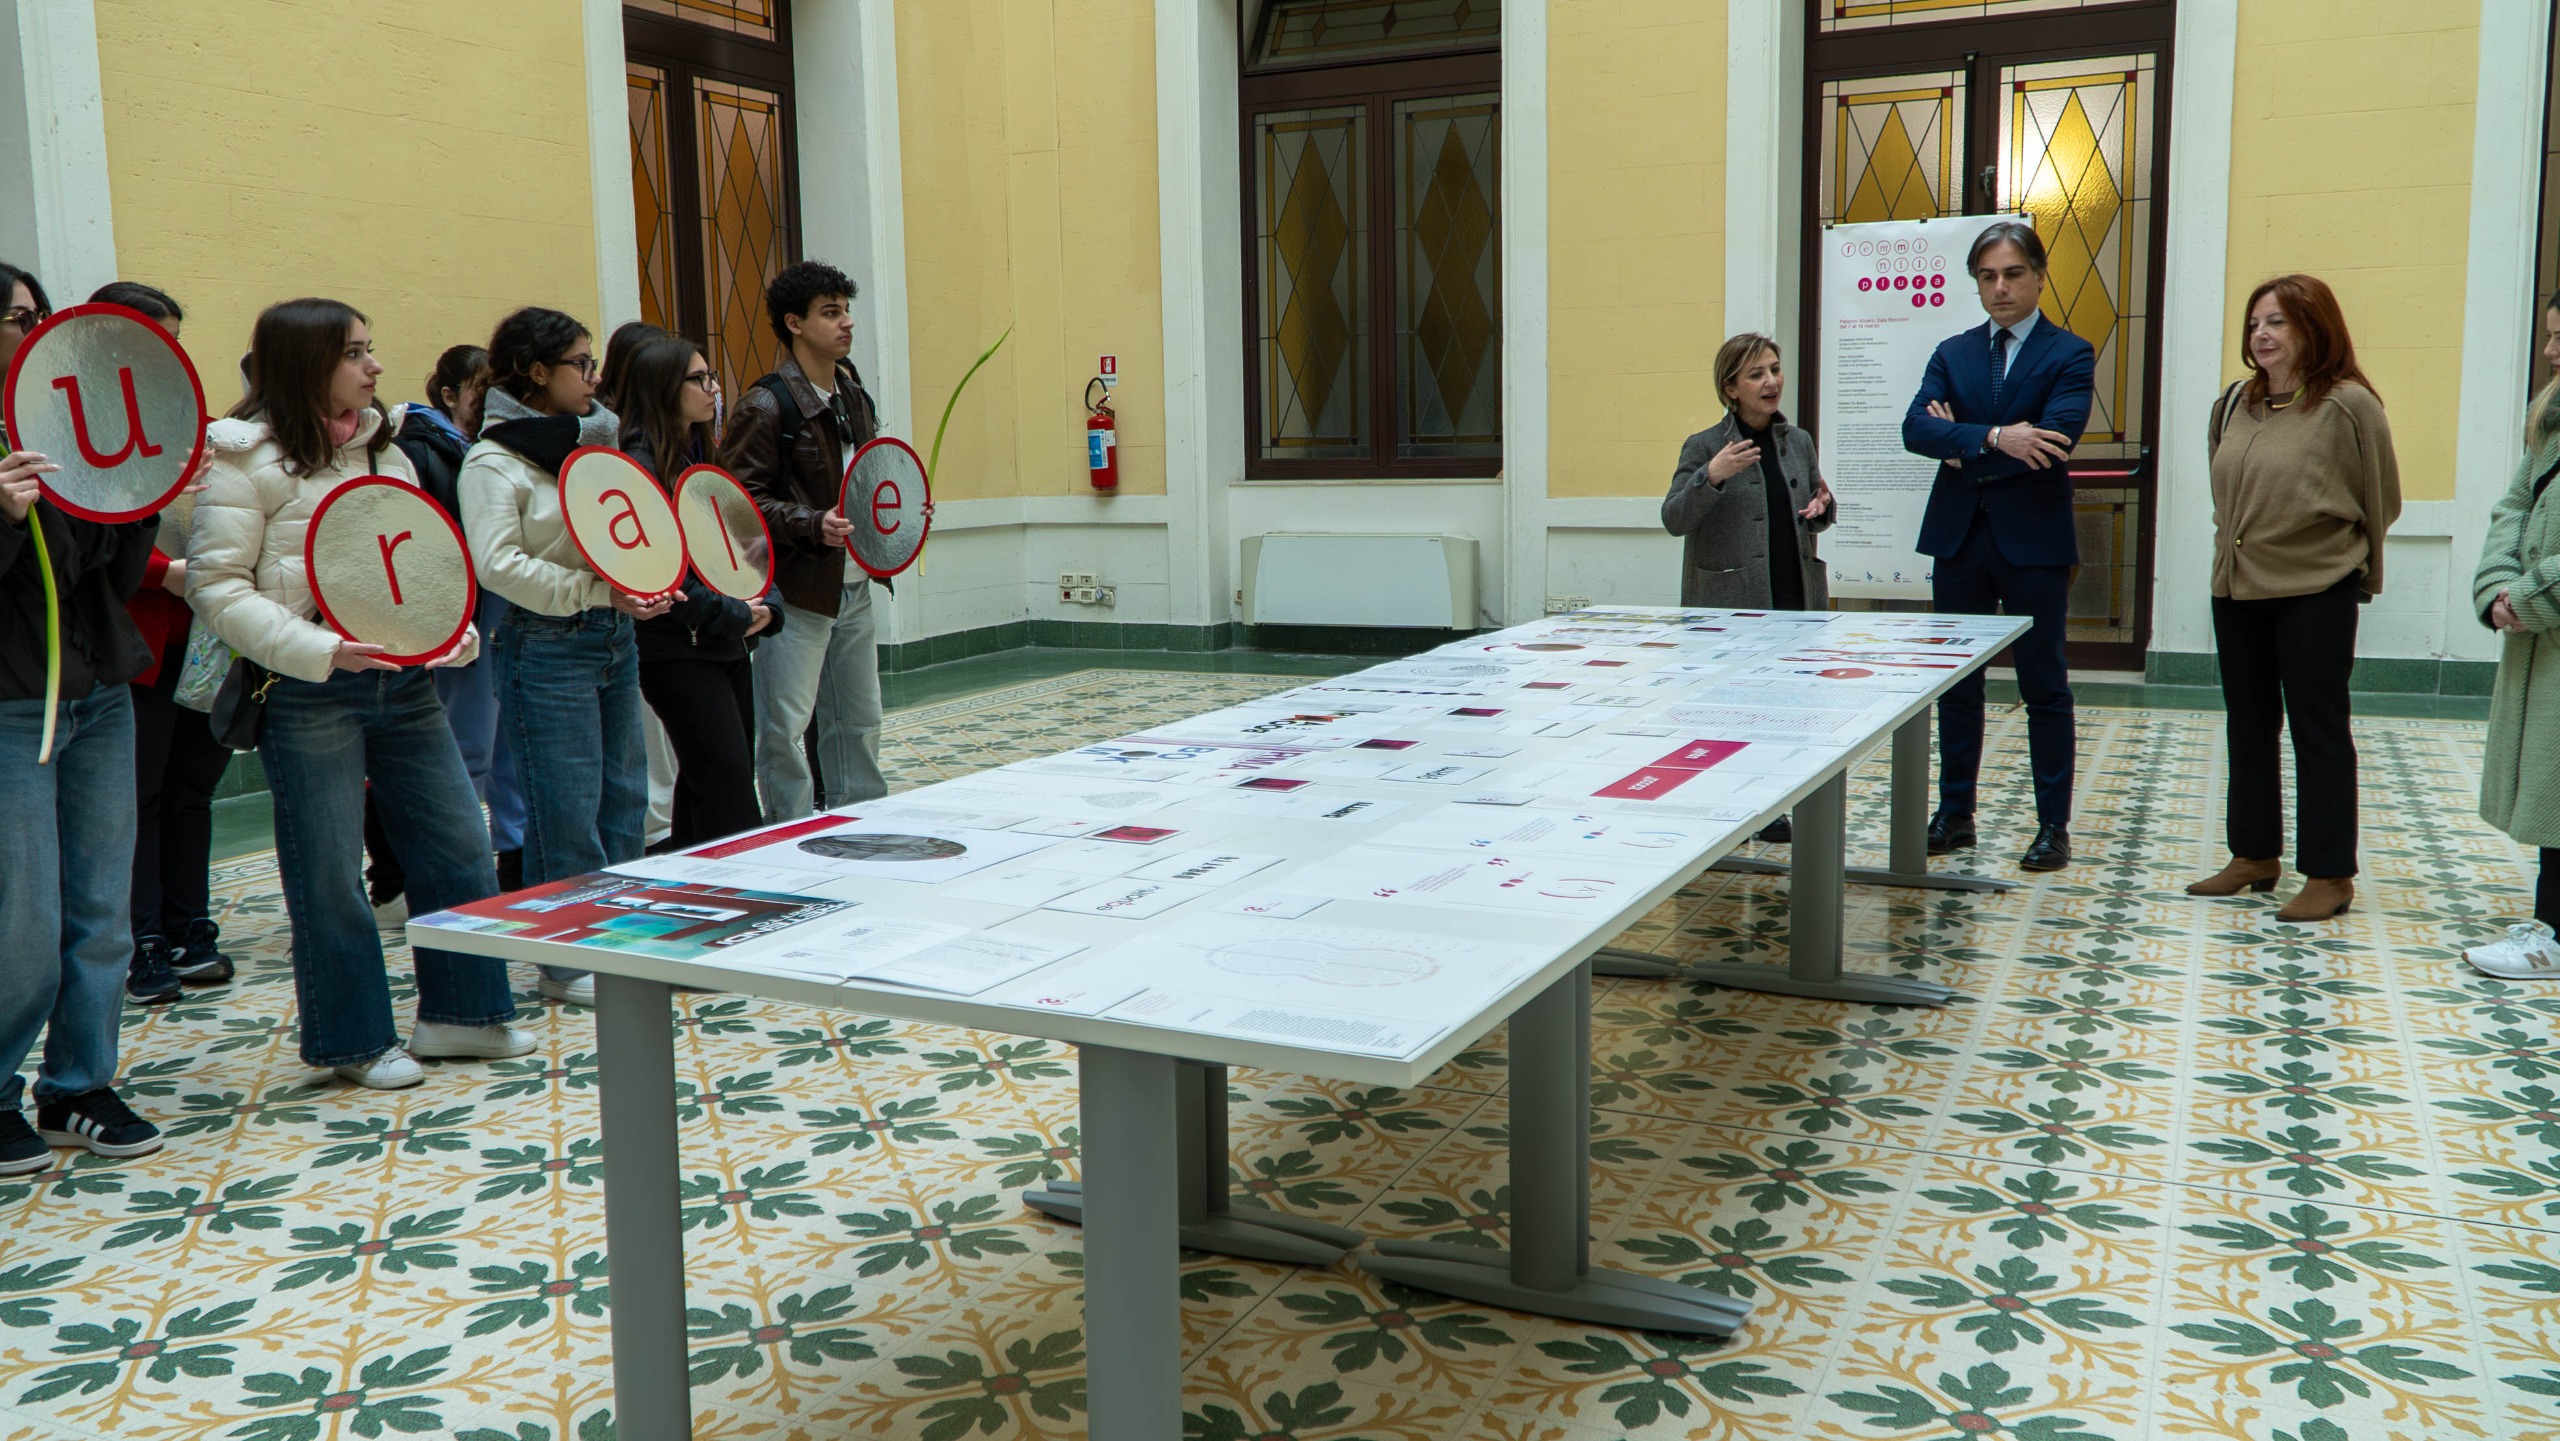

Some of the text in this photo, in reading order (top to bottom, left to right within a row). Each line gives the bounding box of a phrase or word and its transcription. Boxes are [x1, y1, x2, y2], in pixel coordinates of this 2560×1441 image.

[52, 366, 163, 470] u
[597, 488, 651, 551] a
[871, 479, 902, 536] e
[375, 530, 414, 607] r
